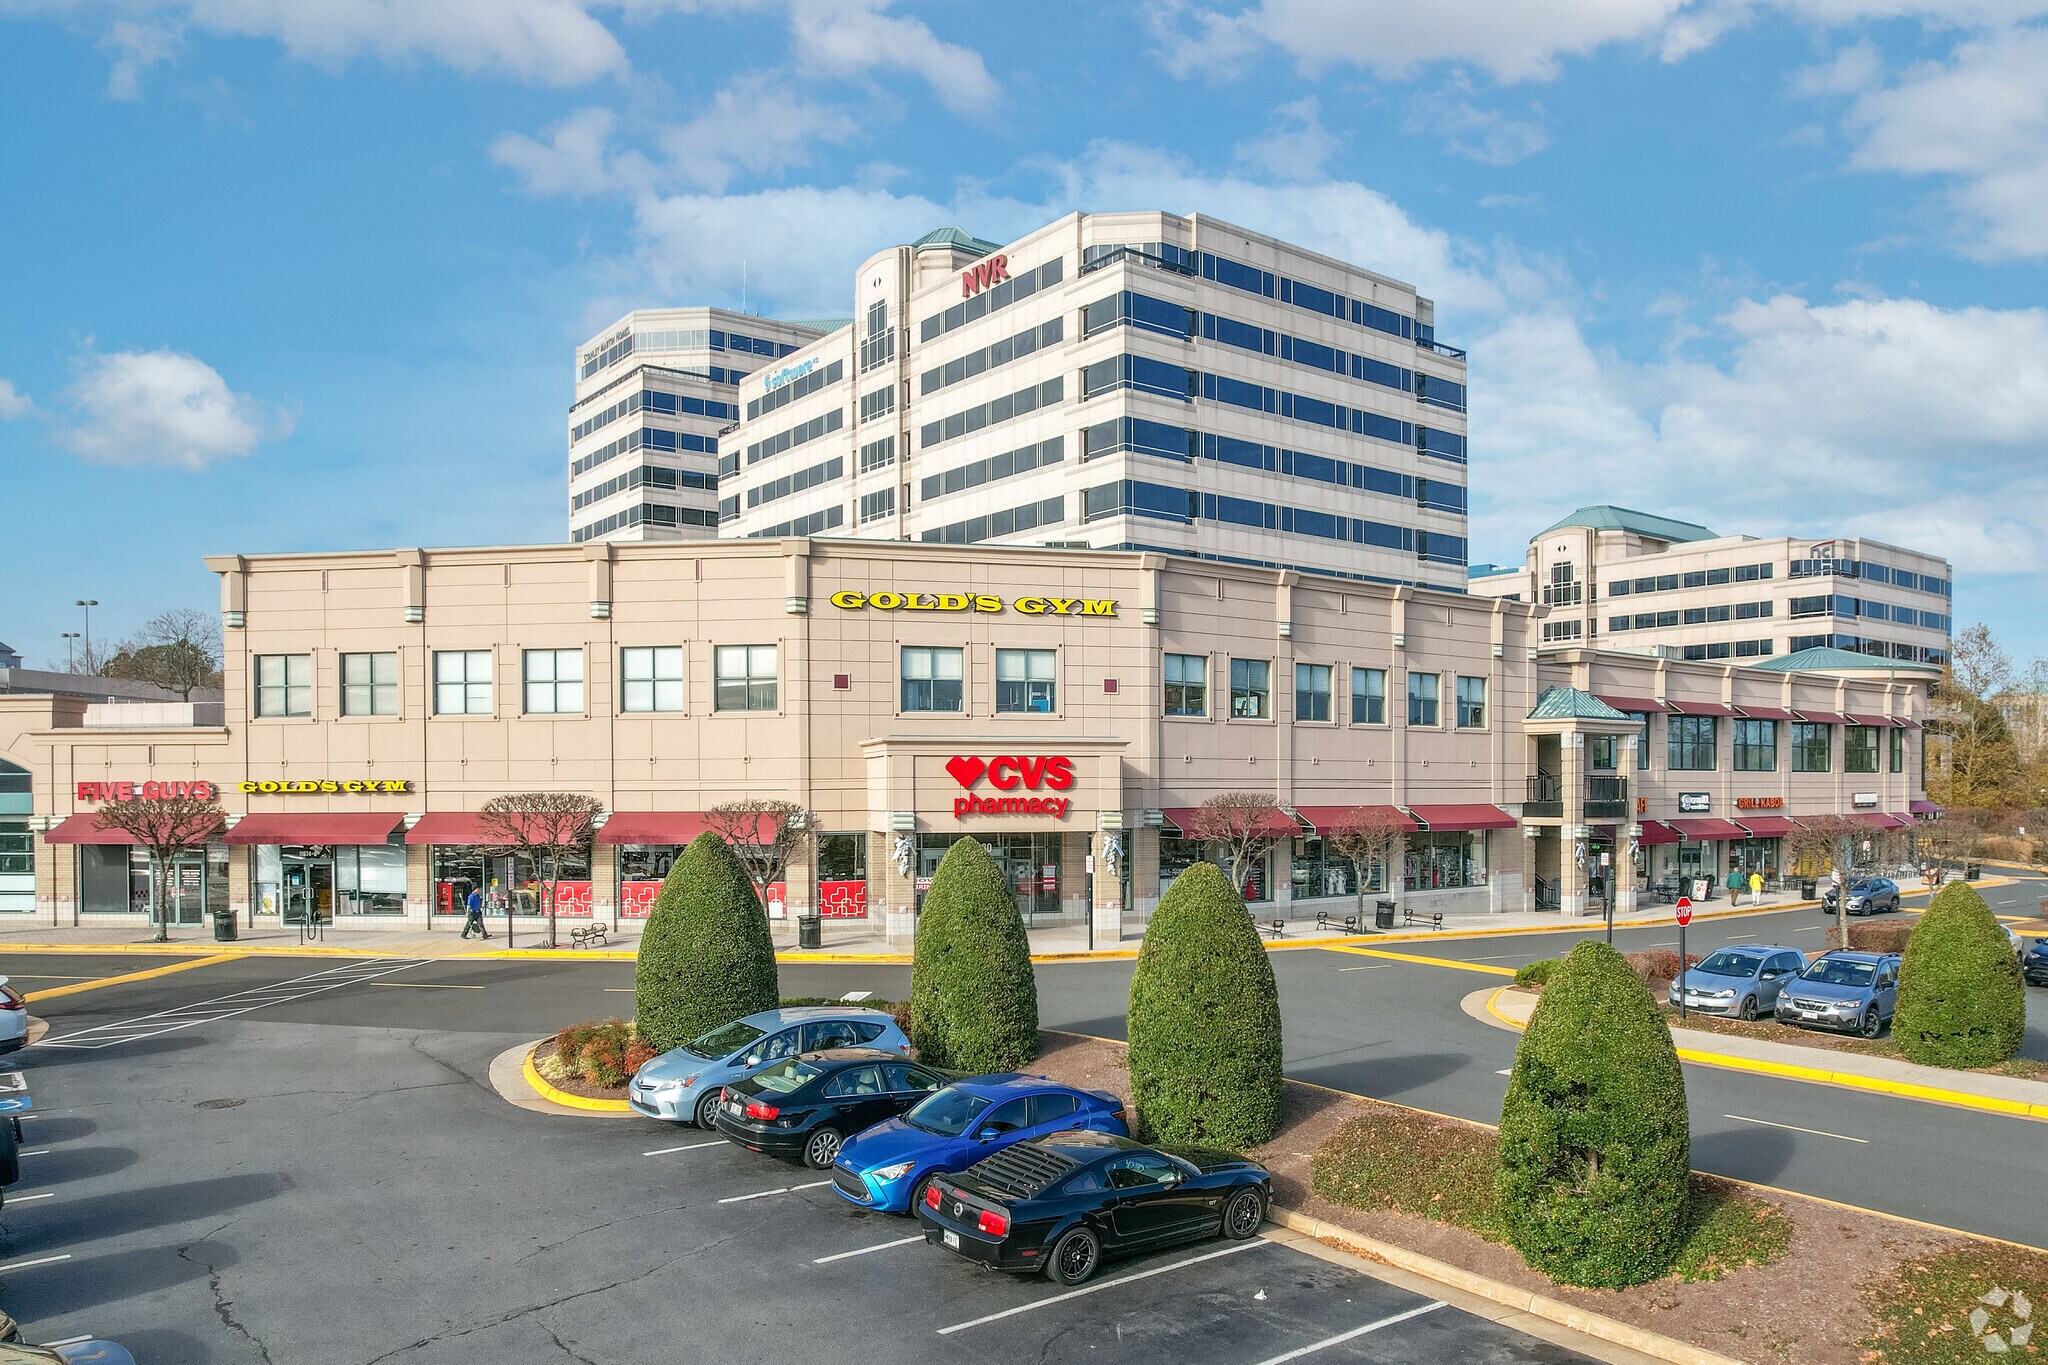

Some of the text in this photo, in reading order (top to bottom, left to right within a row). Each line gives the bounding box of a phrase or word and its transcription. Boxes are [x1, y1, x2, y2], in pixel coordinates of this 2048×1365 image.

[962, 254, 1010, 298] NVR
[772, 360, 812, 389] software
[830, 591, 1119, 617] GOLD'S GYM
[987, 755, 1073, 790] CVS
[78, 780, 212, 801] FIVE GUYS
[238, 779, 409, 793] GOLD'S GYM
[953, 792, 1069, 819] pharmacy
[1637, 797, 1649, 813] AFE
[1738, 797, 1760, 809] GRILL
[1677, 906, 1691, 918] STOP
